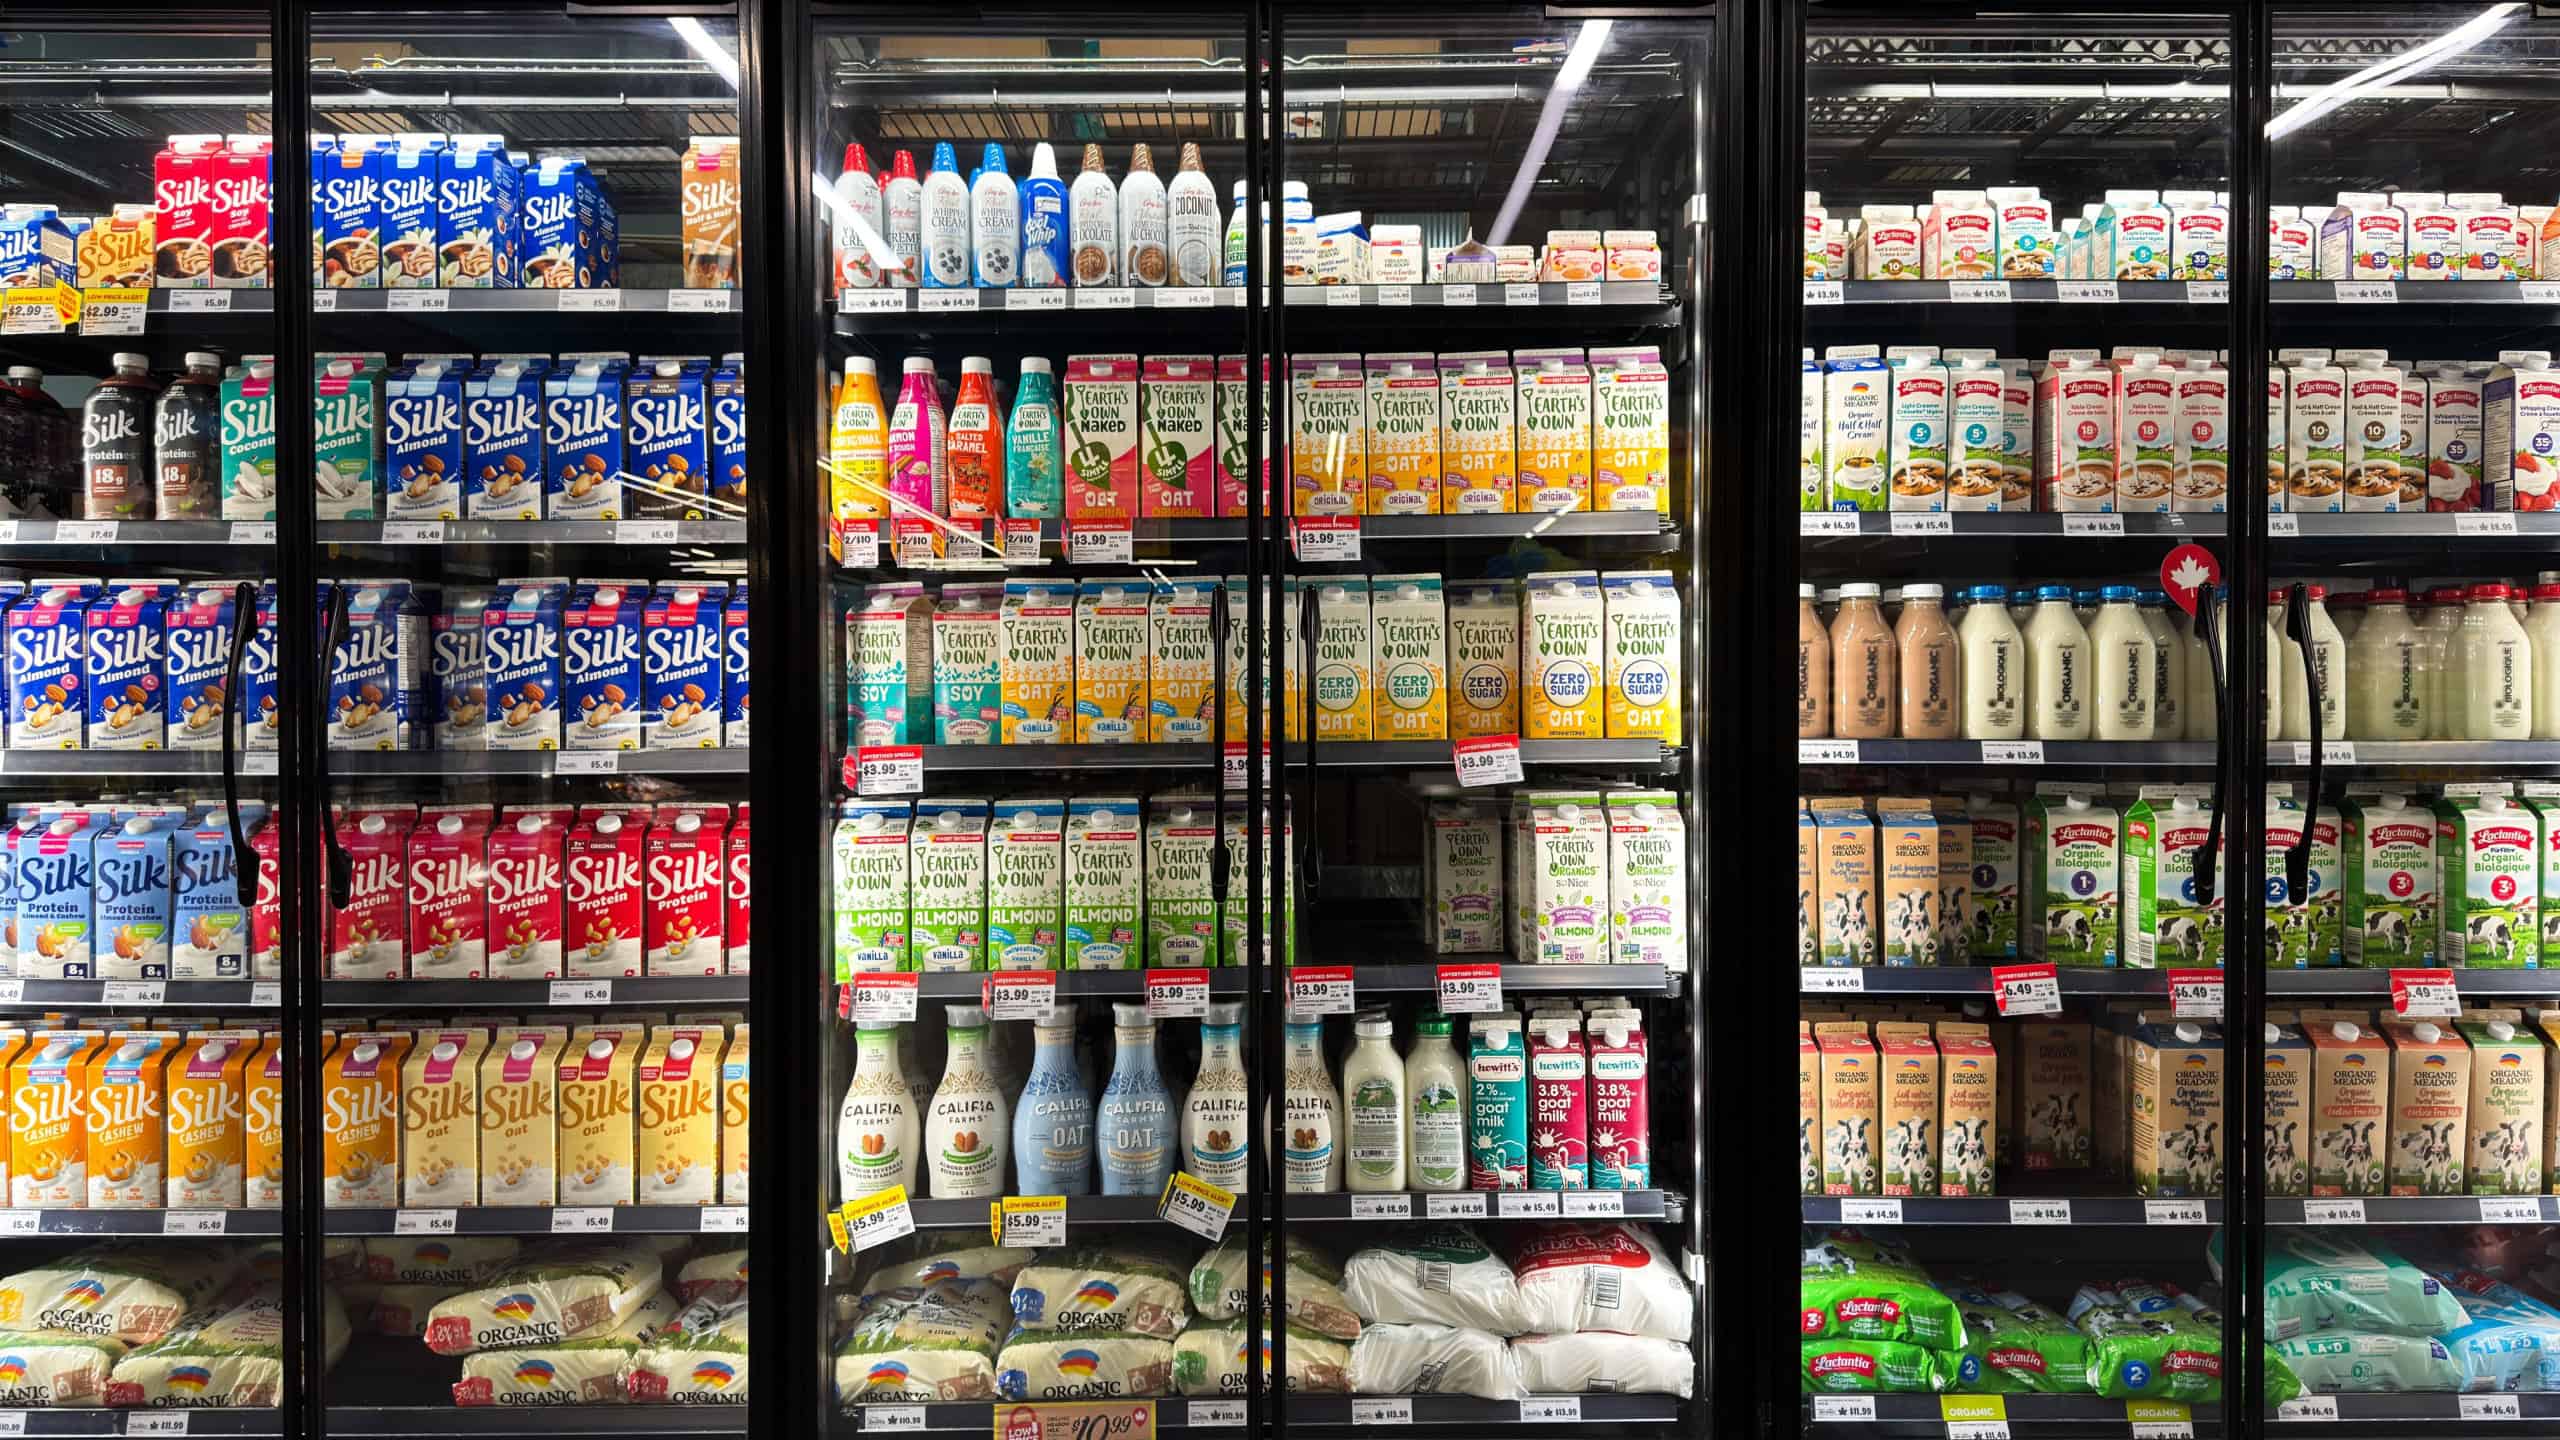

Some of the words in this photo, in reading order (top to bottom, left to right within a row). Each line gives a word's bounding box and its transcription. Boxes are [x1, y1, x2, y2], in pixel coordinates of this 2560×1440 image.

[156, 178, 209, 214] Silk
[212, 178, 266, 214] Silk
[325, 176, 379, 213] Silk
[439, 176, 494, 213] Silk
[173, 208, 192, 218] Soy
[525, 193, 575, 230] Silk
[1175, 197, 1213, 216] COCONUT
[932, 217, 967, 228] CREAM
[8, 305, 41, 317] $2.99
[86, 305, 119, 318] $2.99
[1902, 381, 1941, 394] Lactantia
[2068, 381, 2107, 394] Lactantia
[1085, 391, 1128, 405] EARTH'S
[1535, 397, 1586, 413] EARTH'S
[1612, 396, 1663, 412] EARTH'S
[1091, 405, 1119, 419] OWN
[1384, 400, 1435, 416] EARTH'S
[1459, 399, 1509, 415] EARTH'S
[386, 395, 461, 445] Silk
[466, 395, 541, 445] Silk
[546, 395, 621, 445] Silk
[630, 395, 703, 445] Silk
[1390, 417, 1424, 432] OWN
[1541, 415, 1574, 430] OWN
[83, 410, 140, 448] Silk
[154, 409, 199, 447] Silk
[397, 434, 448, 455] Almond
[558, 434, 608, 454] Almond
[641, 434, 691, 455] Almond
[956, 433, 983, 441] SALTED
[1012, 432, 1049, 444] VANILLE
[1464, 493, 1498, 504] ORIGINAL
[1074, 535, 1106, 546] $3.99
[1301, 533, 1334, 545] $3.99
[1017, 629, 1067, 645] EARTH'S
[1093, 628, 1144, 645] EARTH'S
[1390, 624, 1440, 641] EARTH'S
[10, 625, 88, 676] Silk
[88, 625, 164, 676] Silk
[486, 624, 559, 674] Silk
[565, 624, 639, 674] Silk
[645, 624, 720, 674] Silk
[1099, 646, 1131, 661] OWN
[1396, 644, 1429, 658] OWN
[1554, 641, 1587, 656] OWN
[863, 649, 891, 664] OWN
[19, 664, 69, 684] Almond
[99, 664, 150, 685] Almond
[496, 663, 547, 683] Almond
[656, 663, 708, 684] Almond
[2063, 650, 2073, 702] ORGANIC
[2128, 648, 2138, 702] ORGANIC
[2505, 647, 2513, 702] BIOLOGIQUE
[1393, 676, 1428, 687] ZERO
[1468, 677, 1503, 688] ZERO
[860, 687, 887, 701] SOY
[1393, 687, 1428, 698] SUGAR
[1468, 688, 1503, 699] SUGAR
[1461, 755, 1493, 769] $3.99
[863, 764, 896, 776] $3.99
[2059, 827, 2109, 840] Lactantia
[2377, 828, 2425, 841] Lactantia
[2479, 831, 2527, 844] Lactantia
[1896, 844, 1930, 852] ORGANIC
[2062, 849, 2104, 859] Organic
[2380, 850, 2422, 860] Organic
[2055, 858, 2112, 869] Biologique
[2372, 858, 2429, 870] Biologique
[2482, 853, 2523, 863] Organic
[2474, 862, 2531, 873] Biologique
[18, 856, 94, 902] Silk
[96, 856, 169, 904] Silk
[410, 854, 485, 905] Silk
[489, 854, 561, 905] Silk
[568, 852, 642, 902] Silk
[648, 852, 721, 902] Silk
[933, 874, 967, 888] OWN
[578, 892, 628, 912] Protein
[915, 910, 979, 925] ALMOND
[996, 989, 1029, 1001] $3.99
[1151, 987, 1183, 999] $3.99
[1296, 984, 1327, 996] $3.99
[1442, 982, 1474, 995] $3.99
[2175, 987, 2208, 999] $6.49
[1477, 1060, 1521, 1074] hewitt's
[2491, 1070, 2532, 1078] ORGANIC
[1952, 1078, 1988, 1086] MEADOW
[2333, 1078, 2376, 1086] MEADOW
[2490, 1077, 2533, 1085] MEADOW
[1477, 1084, 1498, 1096] 2%
[1538, 1084, 1571, 1097] 3.8%
[10, 1080, 86, 1133] Silk
[87, 1080, 159, 1134] Silk
[169, 1081, 244, 1134] Silk
[403, 1081, 477, 1132] Silk
[560, 1080, 630, 1129] Silk
[640, 1080, 718, 1129] Silk
[846, 1103, 903, 1117] CALIFIA
[1476, 1102, 1509, 1116] goat
[1477, 1113, 1505, 1128] milk
[24, 1122, 70, 1142] CASHEW
[427, 1125, 449, 1139] oat
[1054, 1127, 1085, 1148] OAT
[1173, 1190, 1205, 1213] $5.99
[1534, 1203, 1556, 1214] $5.49
[430, 1218, 453, 1228] $5.49
[852, 1214, 885, 1237] $5.99
[1008, 1215, 1040, 1228] $5.99
[1841, 1301, 1895, 1315] Lactantia
[478, 1321, 558, 1344] ORGANIC
[1814, 1358, 1871, 1370] Lactantia
[2166, 1354, 2219, 1369] Lactantia
[1043, 1381, 1121, 1398] ORGANIC
[1949, 1408, 1995, 1418] ORGANIC
[2135, 1408, 2179, 1417] ORGANIC
[1008, 1427, 1031, 1438] LOW
